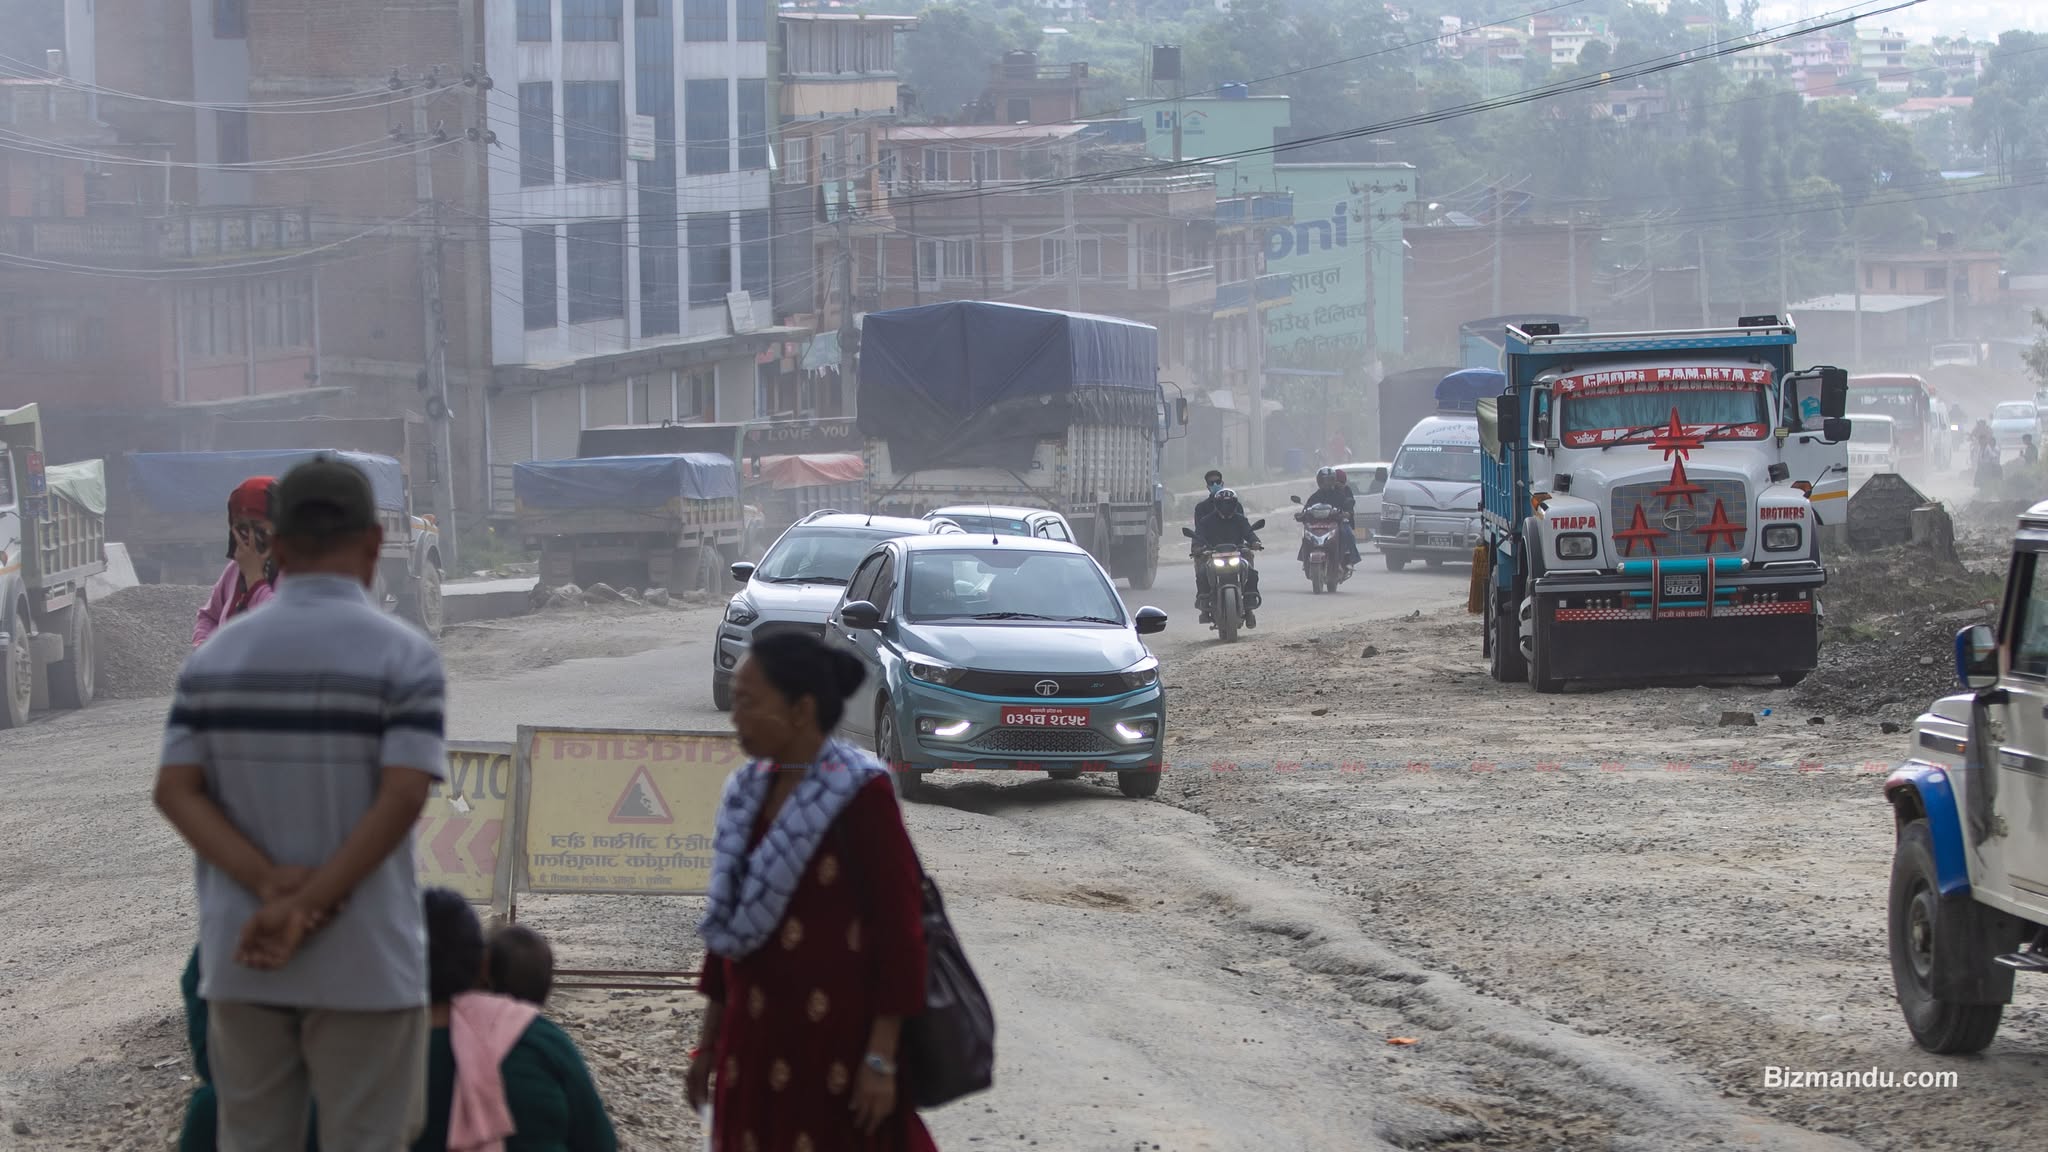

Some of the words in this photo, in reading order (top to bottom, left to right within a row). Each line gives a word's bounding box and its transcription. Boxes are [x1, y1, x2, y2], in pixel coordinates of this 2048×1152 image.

[768, 428, 811, 441] LOVE
[820, 425, 848, 438] YOU
[1760, 507, 1805, 520] BROTHERS
[1551, 516, 1597, 530] THAPA
